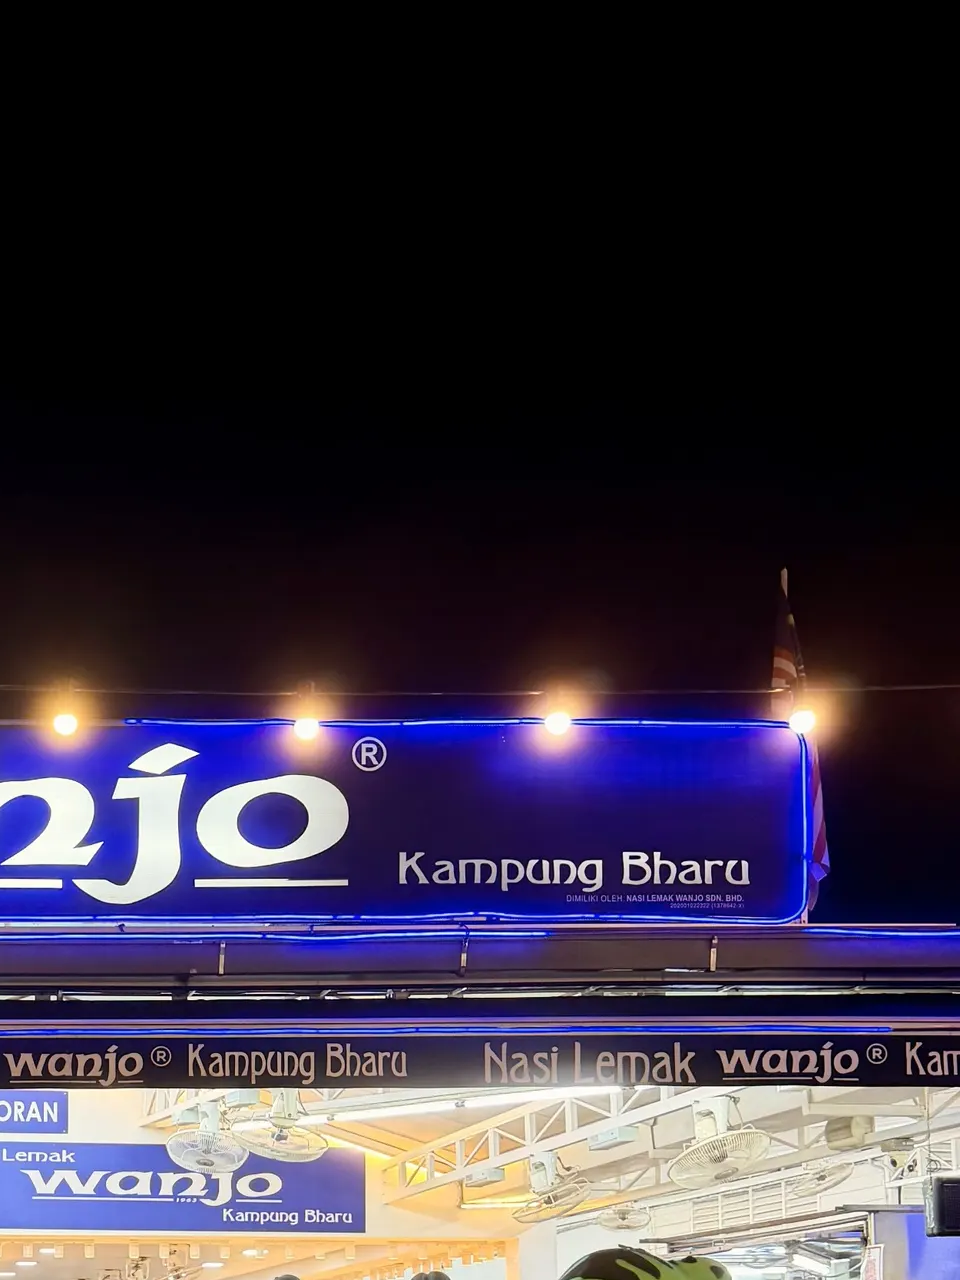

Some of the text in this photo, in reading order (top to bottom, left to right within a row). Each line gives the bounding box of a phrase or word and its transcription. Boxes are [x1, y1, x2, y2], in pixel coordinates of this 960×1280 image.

[398, 851, 751, 893] Kampung Bharu
[566, 894, 745, 903] DIMILIKI OLEH: NASI LEMAK WANJO SDN. BHD.
[4, 1043, 144, 1086] wanjo
[187, 1043, 315, 1085] Kampung
[325, 1043, 408, 1078] Bharu
[483, 1041, 560, 1084] Nasi
[573, 1041, 697, 1085] Lemak
[715, 1041, 860, 1084] wanjo
[2, 1147, 76, 1163] Lemak
[20, 1168, 283, 1207] wanjo
[222, 1207, 353, 1225] Kampung Bharu
